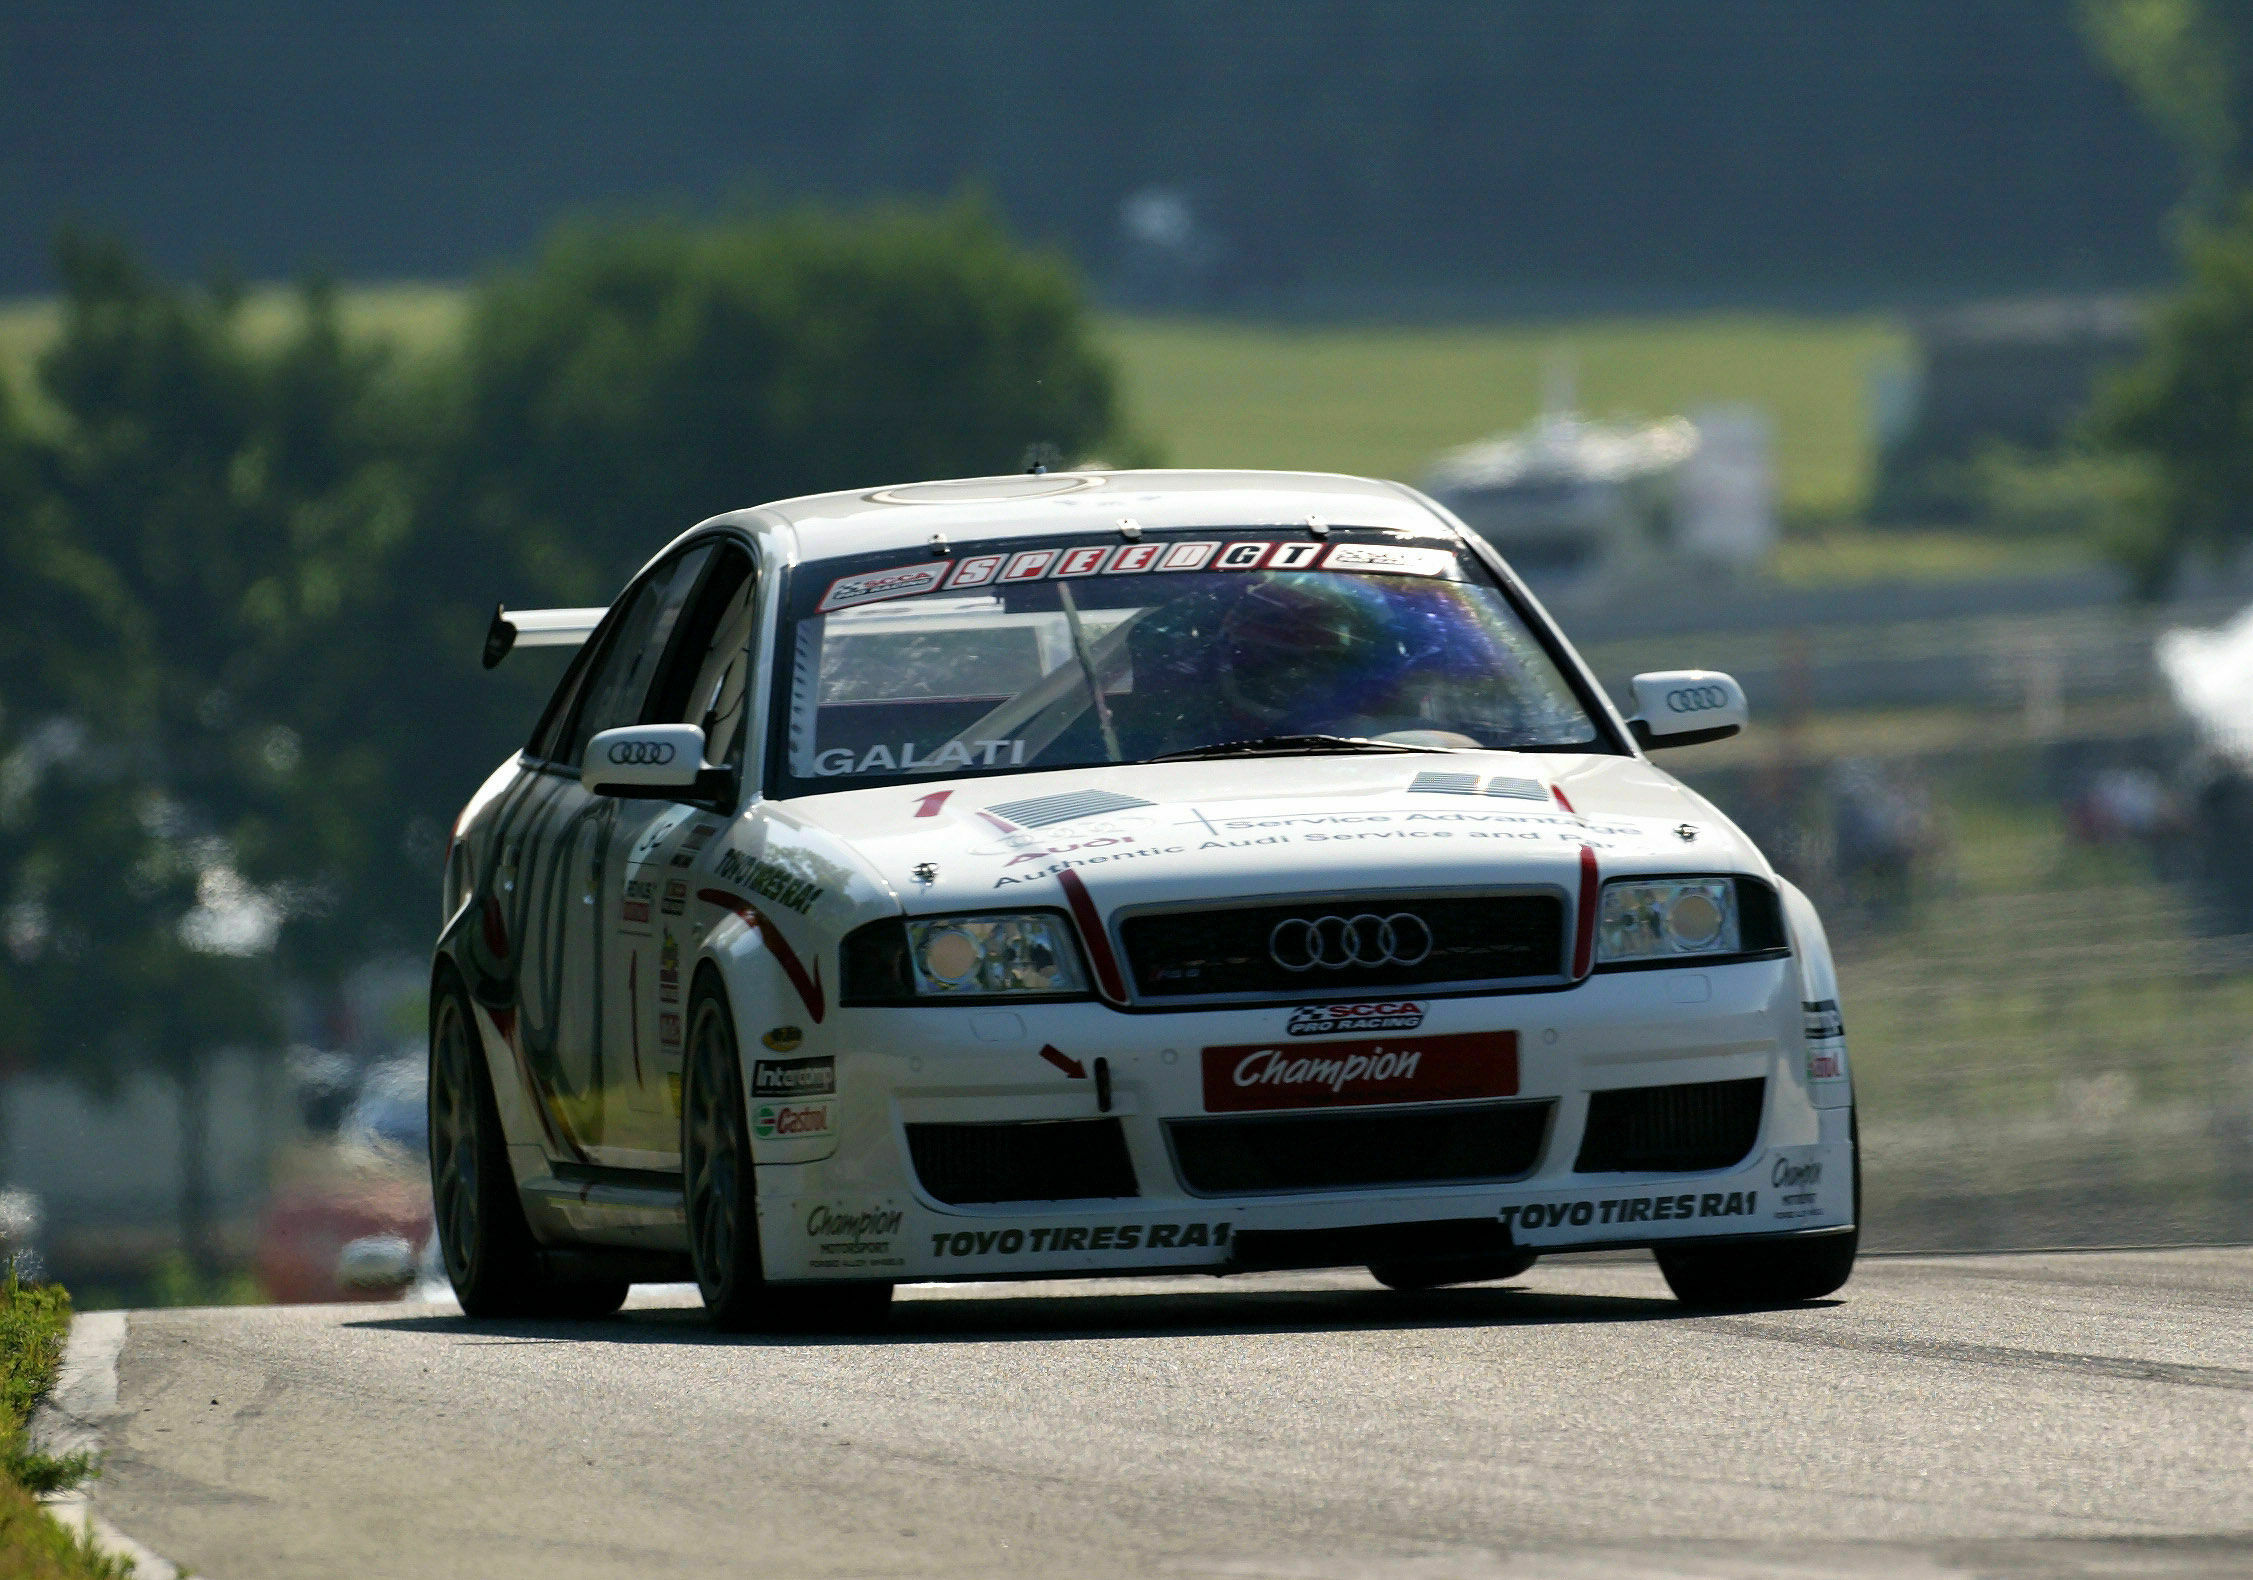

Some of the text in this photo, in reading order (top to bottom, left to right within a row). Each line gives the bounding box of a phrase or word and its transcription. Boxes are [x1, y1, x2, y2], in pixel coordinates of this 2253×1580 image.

[955, 546, 1208, 582] SPEED
[1226, 545, 1313, 566] GT
[813, 740, 1026, 776] GALATI
[911, 790, 954, 817] 1
[1226, 812, 1643, 835] Service Advantage
[993, 846, 1185, 889] Authentic
[1198, 835, 1289, 850] Audi
[1303, 827, 1454, 842] Service
[1468, 830, 1541, 841] and
[1290, 1016, 1420, 1034] PRO RACING
[1329, 1002, 1422, 1018] SCCA
[1232, 1046, 1422, 1092] Champion
[806, 1205, 904, 1242] Champion
[1500, 1201, 1594, 1230] TOYO
[1600, 1194, 1695, 1224] TIRES
[1700, 1190, 1759, 1217] RA1
[931, 1221, 1232, 1257] TOYO TIRES RA1
